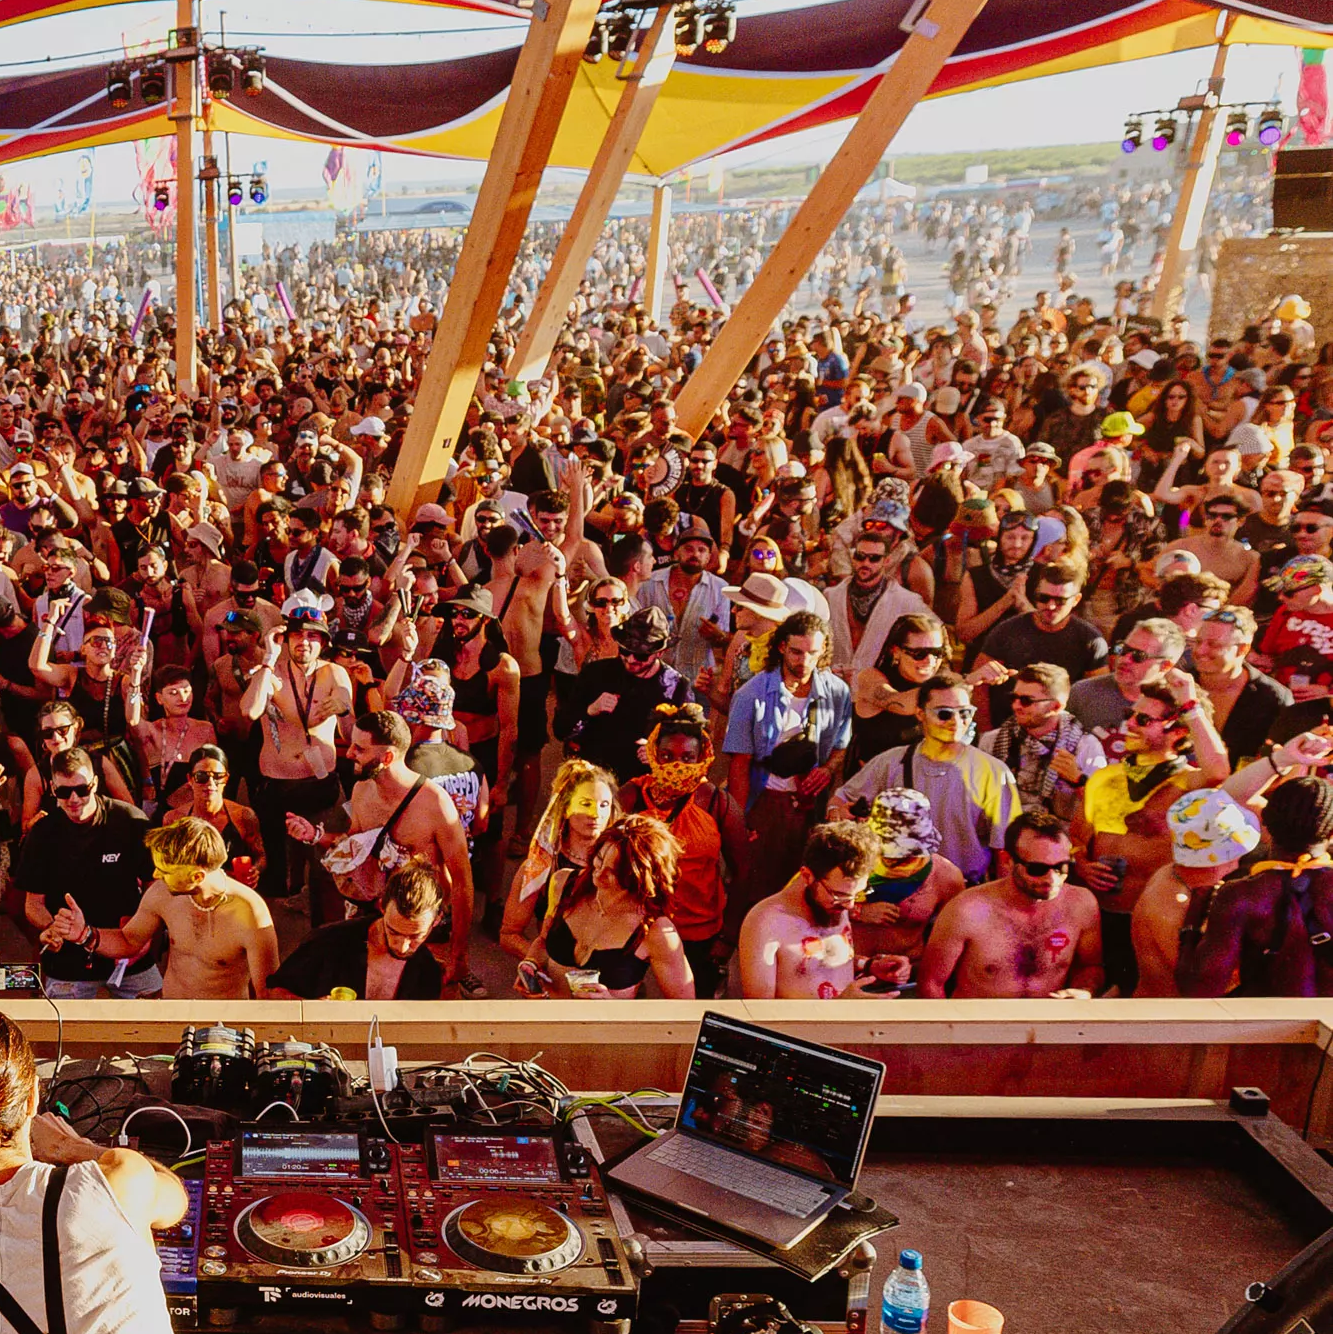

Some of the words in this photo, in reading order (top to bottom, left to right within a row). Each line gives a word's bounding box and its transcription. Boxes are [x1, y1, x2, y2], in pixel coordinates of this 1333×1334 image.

[101, 853, 121, 863] KEY
[291, 1290, 347, 1300] audiovisuales
[461, 1293, 580, 1313] MONEGROS
